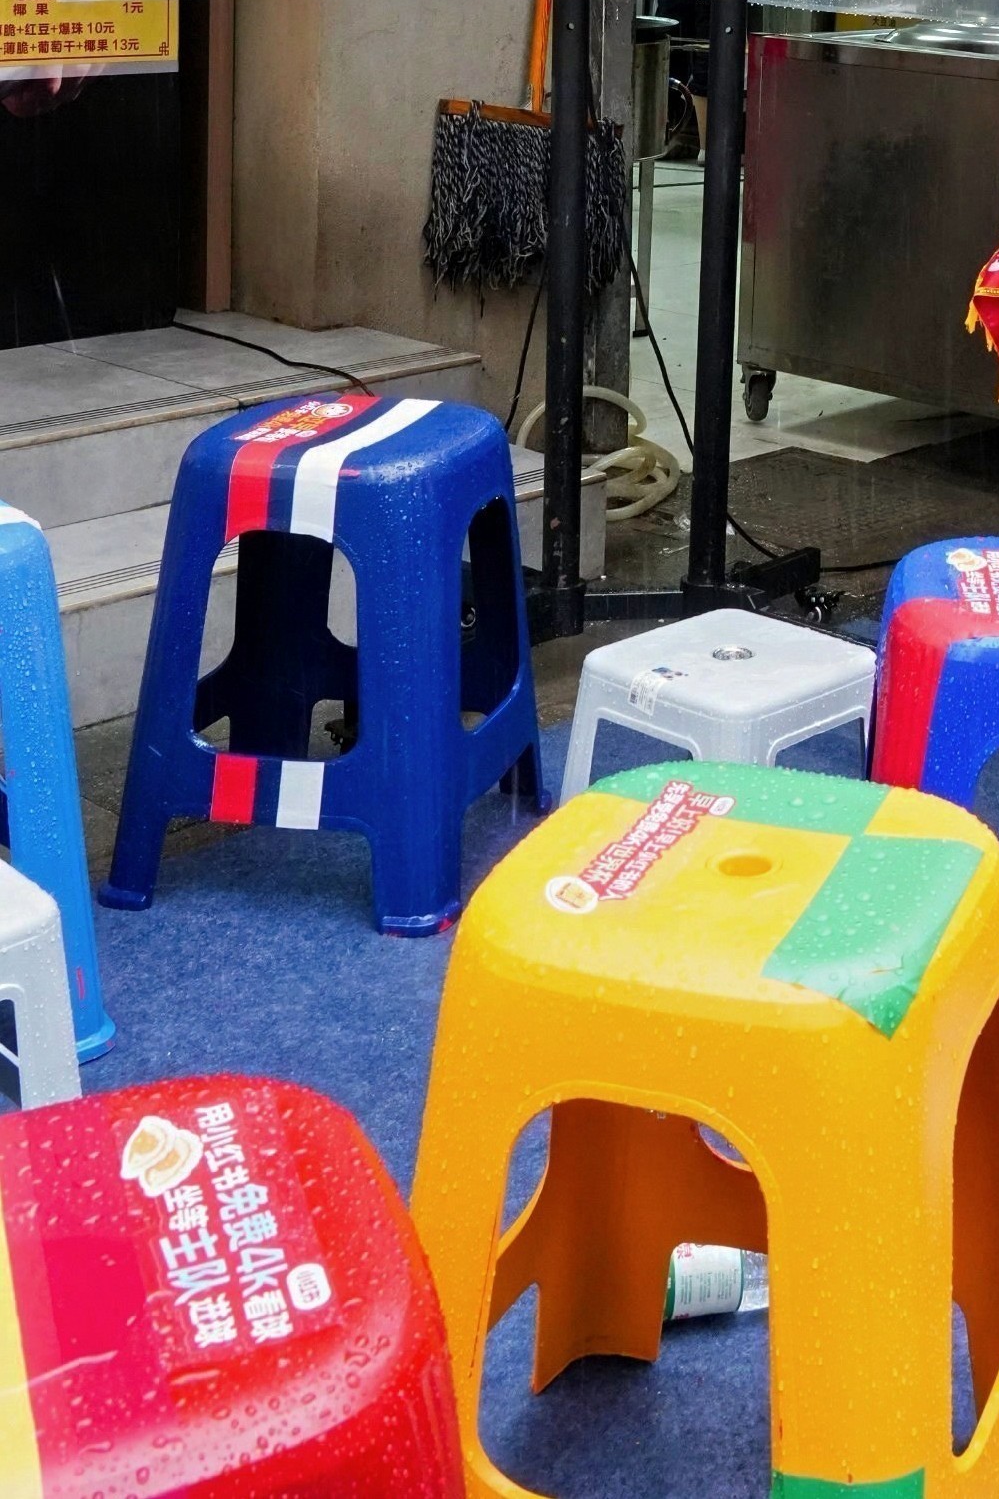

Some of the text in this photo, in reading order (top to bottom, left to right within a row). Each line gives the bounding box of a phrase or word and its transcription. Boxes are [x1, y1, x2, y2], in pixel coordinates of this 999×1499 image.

[122, 2, 144, 14] 1元
[0, 21, 115, 37] 脆+红豆+爆珠 10元
[112, 38, 140, 51] 13元
